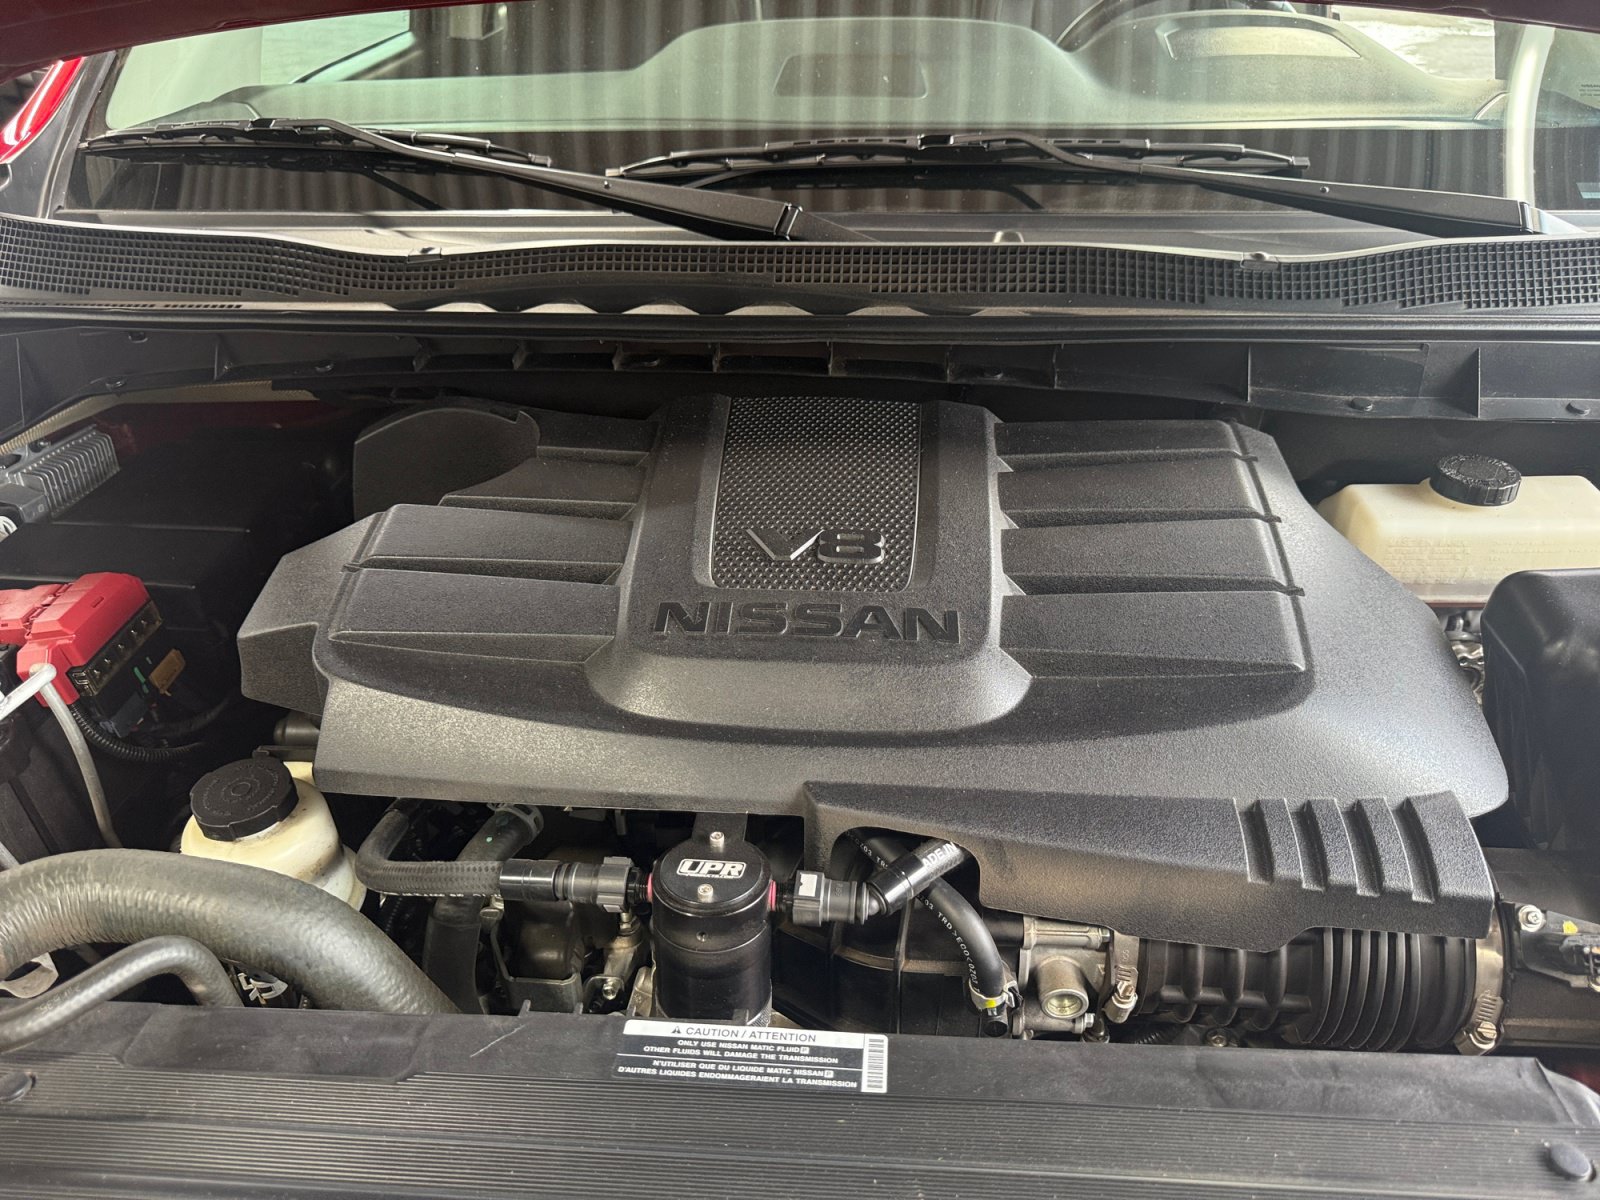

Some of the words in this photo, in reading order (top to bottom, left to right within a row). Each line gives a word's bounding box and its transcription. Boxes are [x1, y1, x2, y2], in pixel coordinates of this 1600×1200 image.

[746, 528, 885, 564] V8
[652, 601, 961, 644] NISSAN
[679, 860, 744, 877] UPR
[686, 1027, 737, 1038] CAUTION
[749, 1031, 817, 1043] ATTENTION
[718, 1042, 749, 1050] NISSAN
[750, 1044, 775, 1052] MATIC
[672, 1048, 701, 1056] FLUIDS
[703, 1049, 722, 1057] WILL
[724, 1051, 759, 1059] DAMAGE
[778, 1054, 839, 1064] TRANSMISSION
[617, 1066, 658, 1075] D'AUTRES
[658, 1069, 697, 1077] LIQUIDES
[698, 1072, 780, 1082] ENDOMMAGERAIENT
[782, 1076, 795, 1084] LA
[796, 1077, 858, 1088] TRANSMISSION
[652, 1060, 697, 1069] N'UTILISER
[698, 1062, 716, 1070] QUE
[732, 1065, 764, 1073] LIQUIDE
[766, 1067, 792, 1075] MATIC
[793, 1068, 823, 1077] NISSAN
